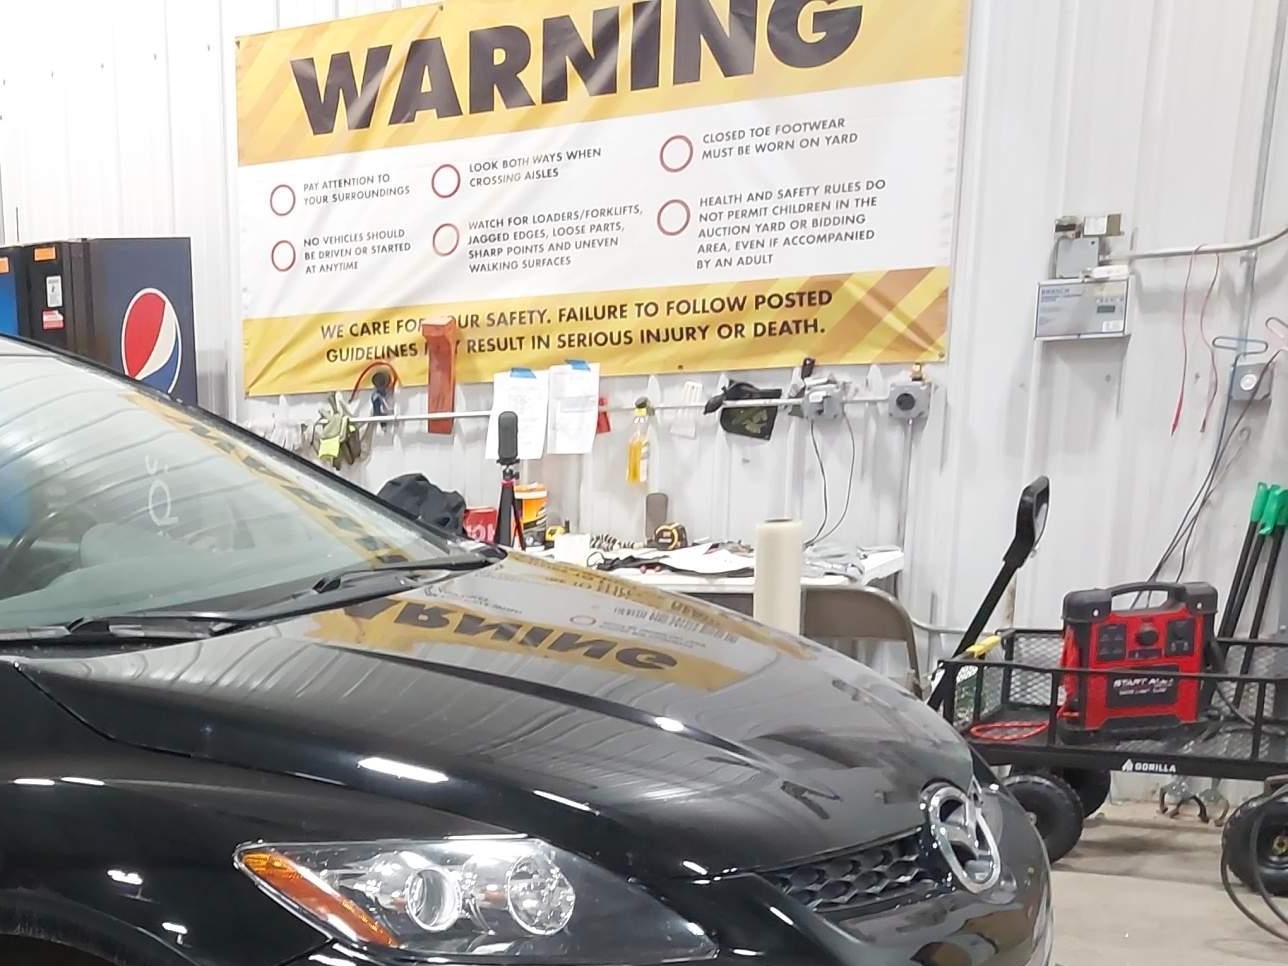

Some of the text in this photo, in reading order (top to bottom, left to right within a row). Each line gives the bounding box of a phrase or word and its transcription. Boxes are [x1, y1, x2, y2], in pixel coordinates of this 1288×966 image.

[289, 0, 863, 136] WARNING
[703, 118, 846, 144] CLOSED TOE FOOTWEAR
[702, 133, 858, 160] MUST BE WORN ON YARD
[469, 148, 602, 173] LOOK BOTH WAYS WHEN
[303, 173, 391, 192] PAY ATTENTION TO
[469, 167, 559, 187] CROSSING AISLES
[304, 185, 411, 206] YOUR SURROUNDINGS
[700, 179, 887, 207] HEALTH AND SAFETY RULES DO
[468, 204, 643, 230] WATCH FOR LOADERS/FORKLIFTS,
[698, 196, 878, 223] NOT PERMIT CHILDREN IN THE
[303, 229, 405, 247] NO VEHICLES SHOULD
[468, 221, 625, 246] JAGGED EDGES, LOOSE PARTS,
[698, 213, 866, 238] AUCTION YARD OR BIDDING
[304, 242, 411, 261] BE DRIVEN OR STARTED
[469, 237, 619, 260] SHARP POINTS AND UNEVEN
[697, 229, 875, 254] AREA, EVEN IF ACCOMPANIED
[305, 261, 359, 275] AT ANYTIME
[469, 256, 571, 273] WALKING SURFACES
[696, 253, 773, 270] BY AN ADULT
[321, 324, 344, 339] WE
[349, 320, 390, 337] CARE
[486, 308, 552, 327] SAFETY.
[558, 303, 628, 323] FAILURE
[634, 301, 659, 318] TO
[666, 295, 747, 316] FOLLOW
[754, 289, 833, 311] POSTED
[326, 343, 418, 364] GUIDELINES
[467, 336, 525, 354] RESULT
[531, 334, 551, 350] IN
[557, 329, 634, 349] SERIOUS
[639, 324, 710, 344] INJURY
[717, 322, 746, 339] OR
[753, 318, 827, 338] DEATH.
[1134, 762, 1176, 773] GORILLA
